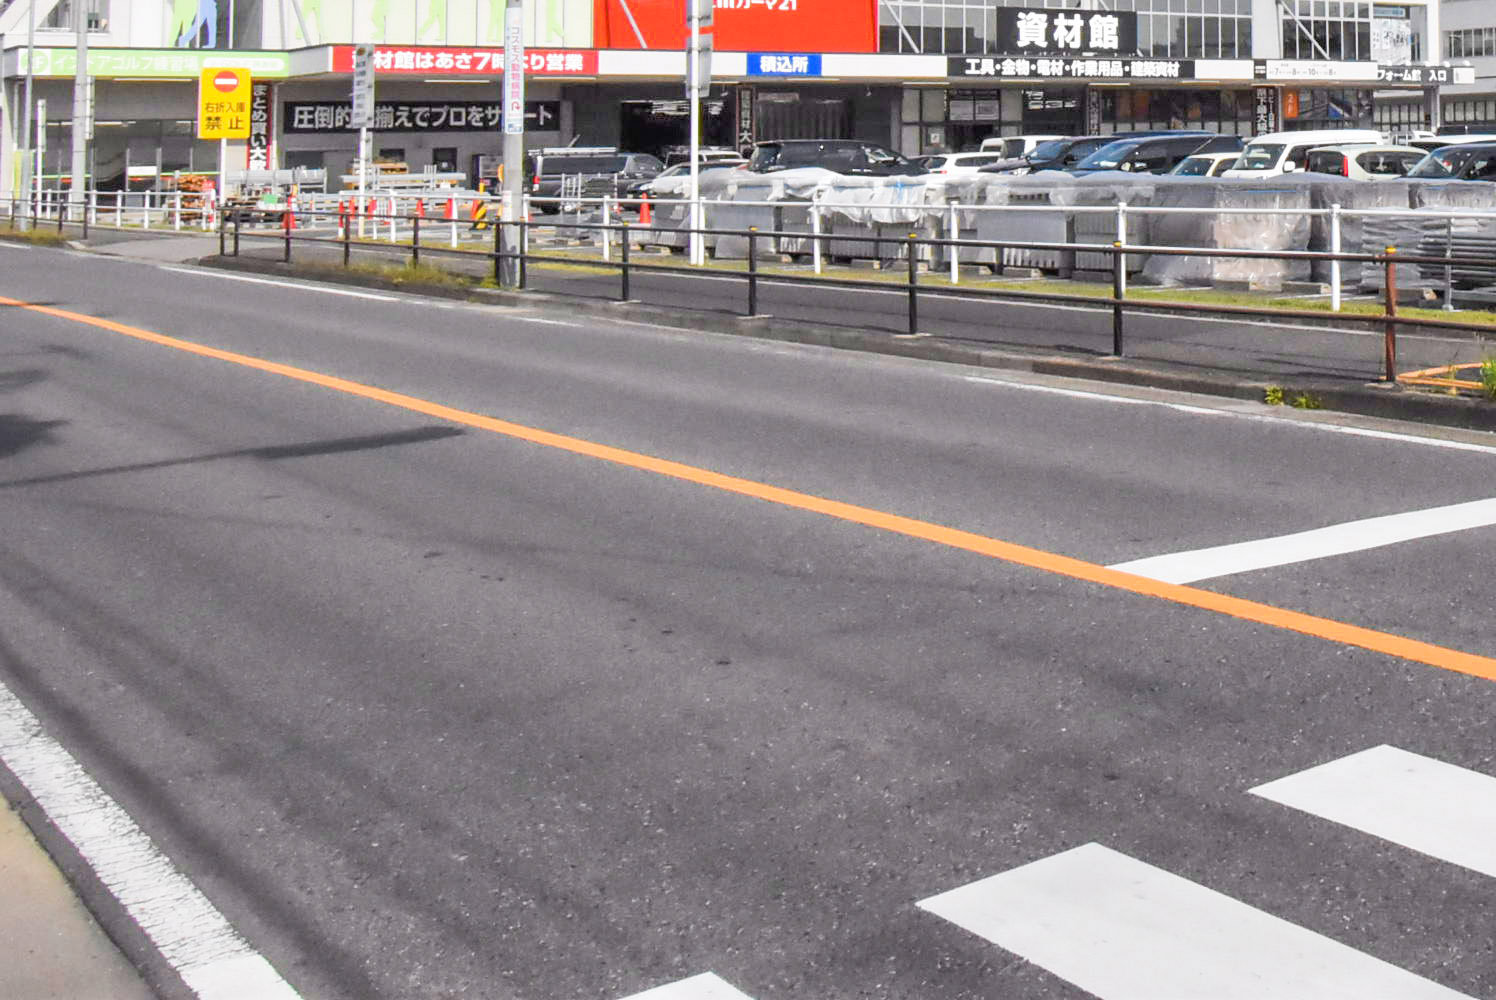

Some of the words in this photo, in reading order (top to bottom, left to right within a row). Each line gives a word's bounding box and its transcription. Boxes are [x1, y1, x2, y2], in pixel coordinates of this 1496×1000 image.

[1016, 11, 1119, 50] 資材館
[351, 51, 583, 71] 材館はあさ7時り営業
[760, 56, 809, 73] 積込所
[1429, 69, 1447, 82] 入口
[205, 102, 246, 113] 右折入庫
[204, 116, 245, 131] 禁止
[293, 104, 553, 130] 圧倒的揃えでプロをサート
